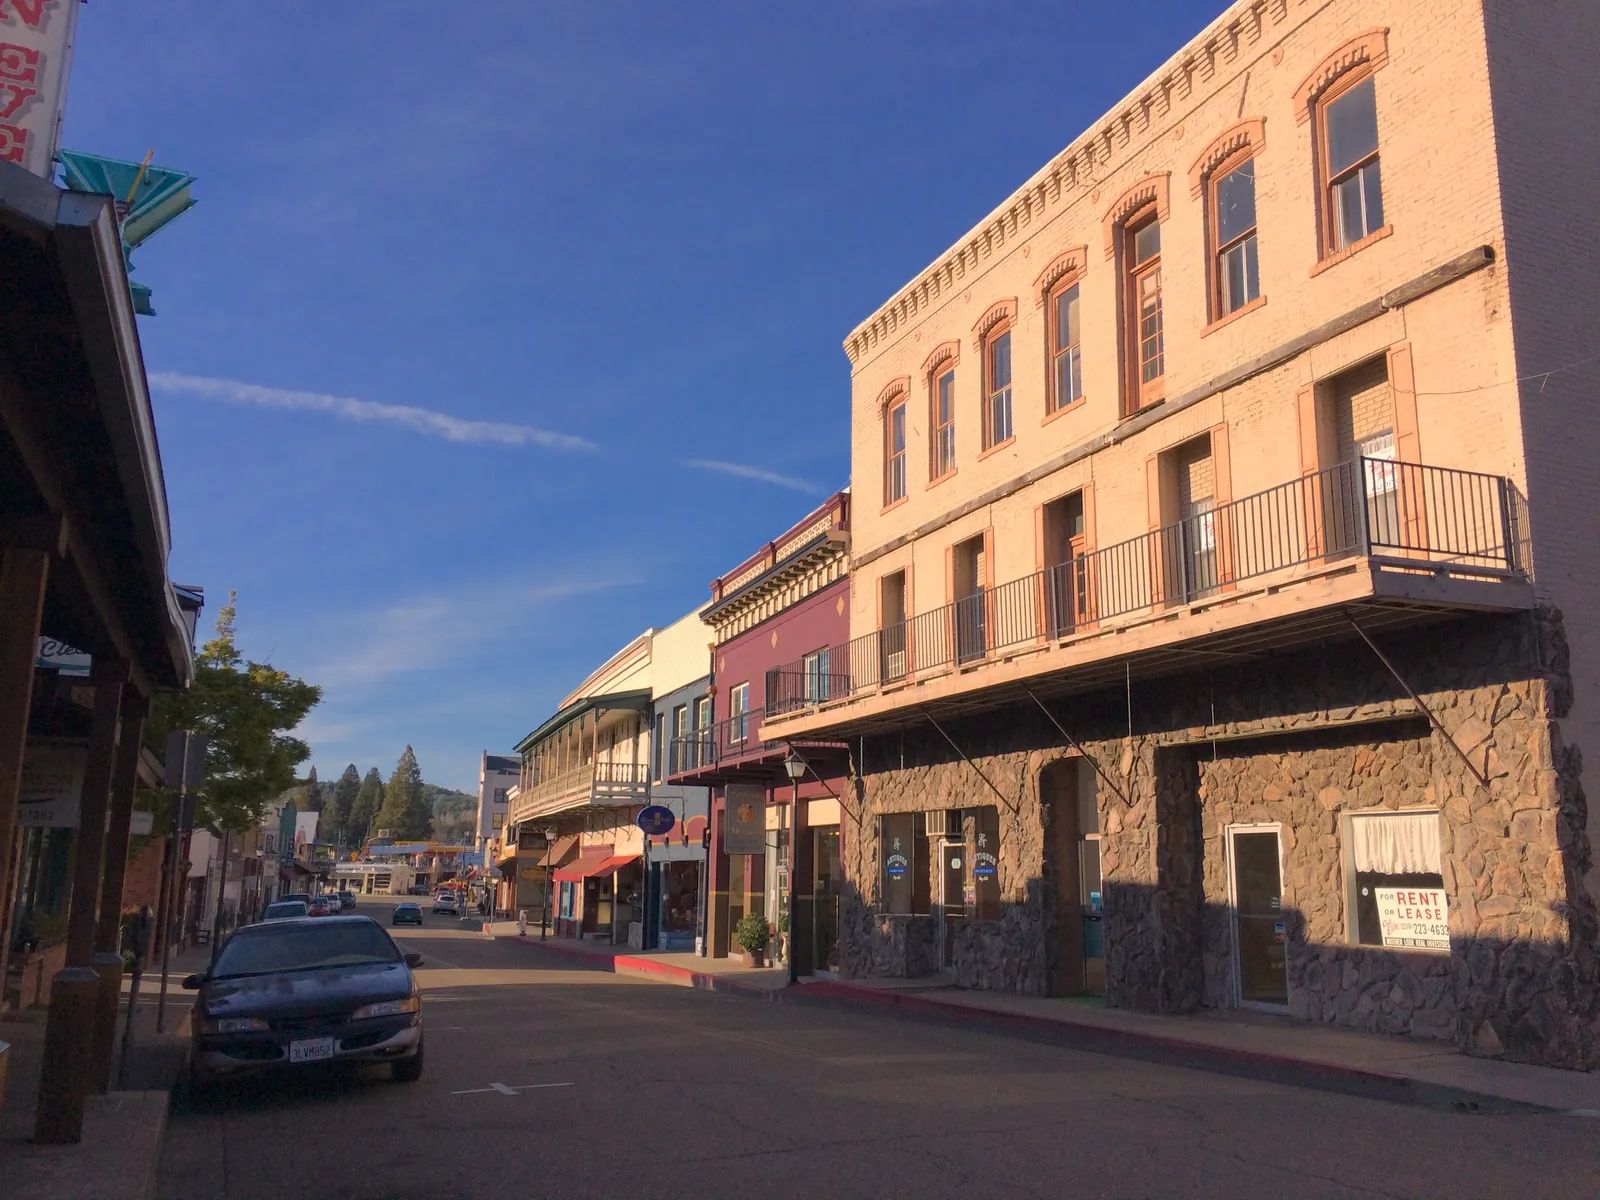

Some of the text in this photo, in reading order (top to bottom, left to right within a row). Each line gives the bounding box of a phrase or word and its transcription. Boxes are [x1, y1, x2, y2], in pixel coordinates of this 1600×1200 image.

[1396, 892, 1439, 906] RENT
[1397, 908, 1442, 920] LEASE
[1413, 923, 1450, 936] 223-4633
